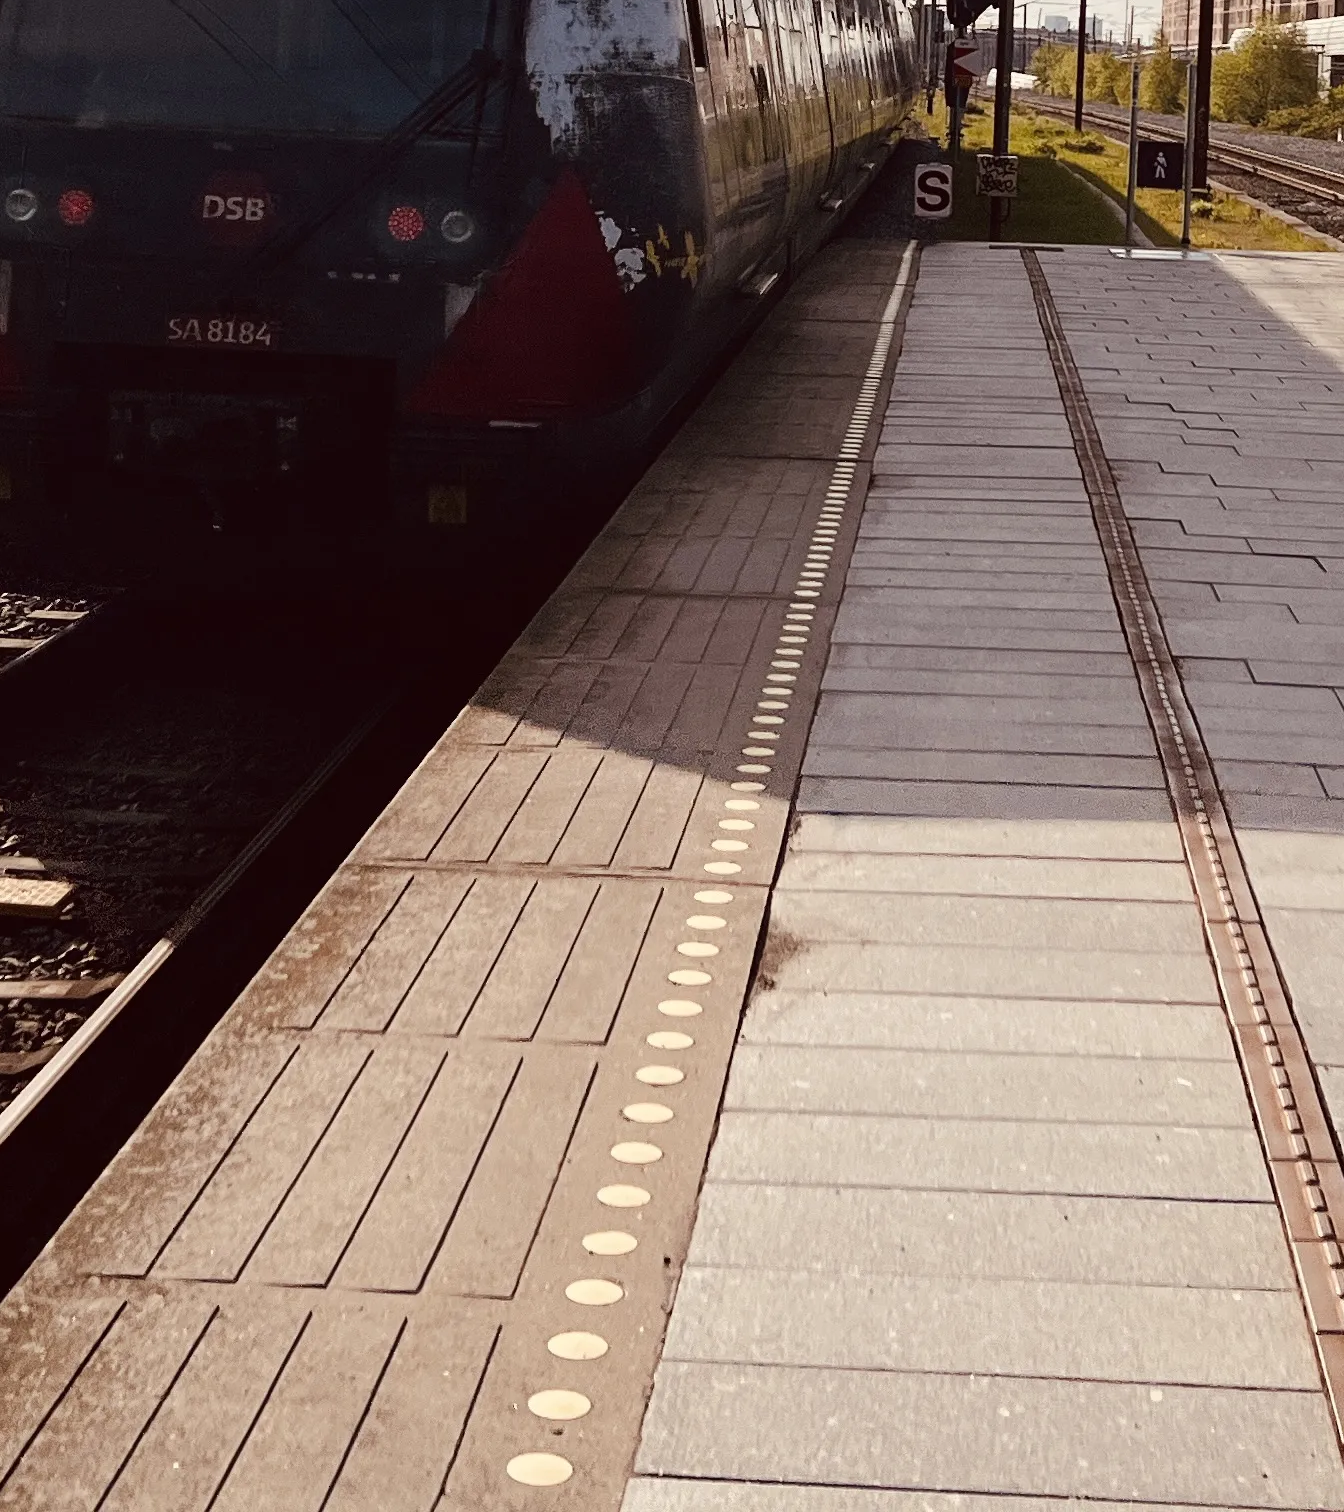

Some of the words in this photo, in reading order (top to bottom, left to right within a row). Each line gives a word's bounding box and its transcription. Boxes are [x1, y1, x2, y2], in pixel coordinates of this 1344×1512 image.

[917, 169, 951, 212] S
[202, 194, 265, 222] DSB
[167, 317, 203, 341] SA
[206, 318, 272, 347] 8184
